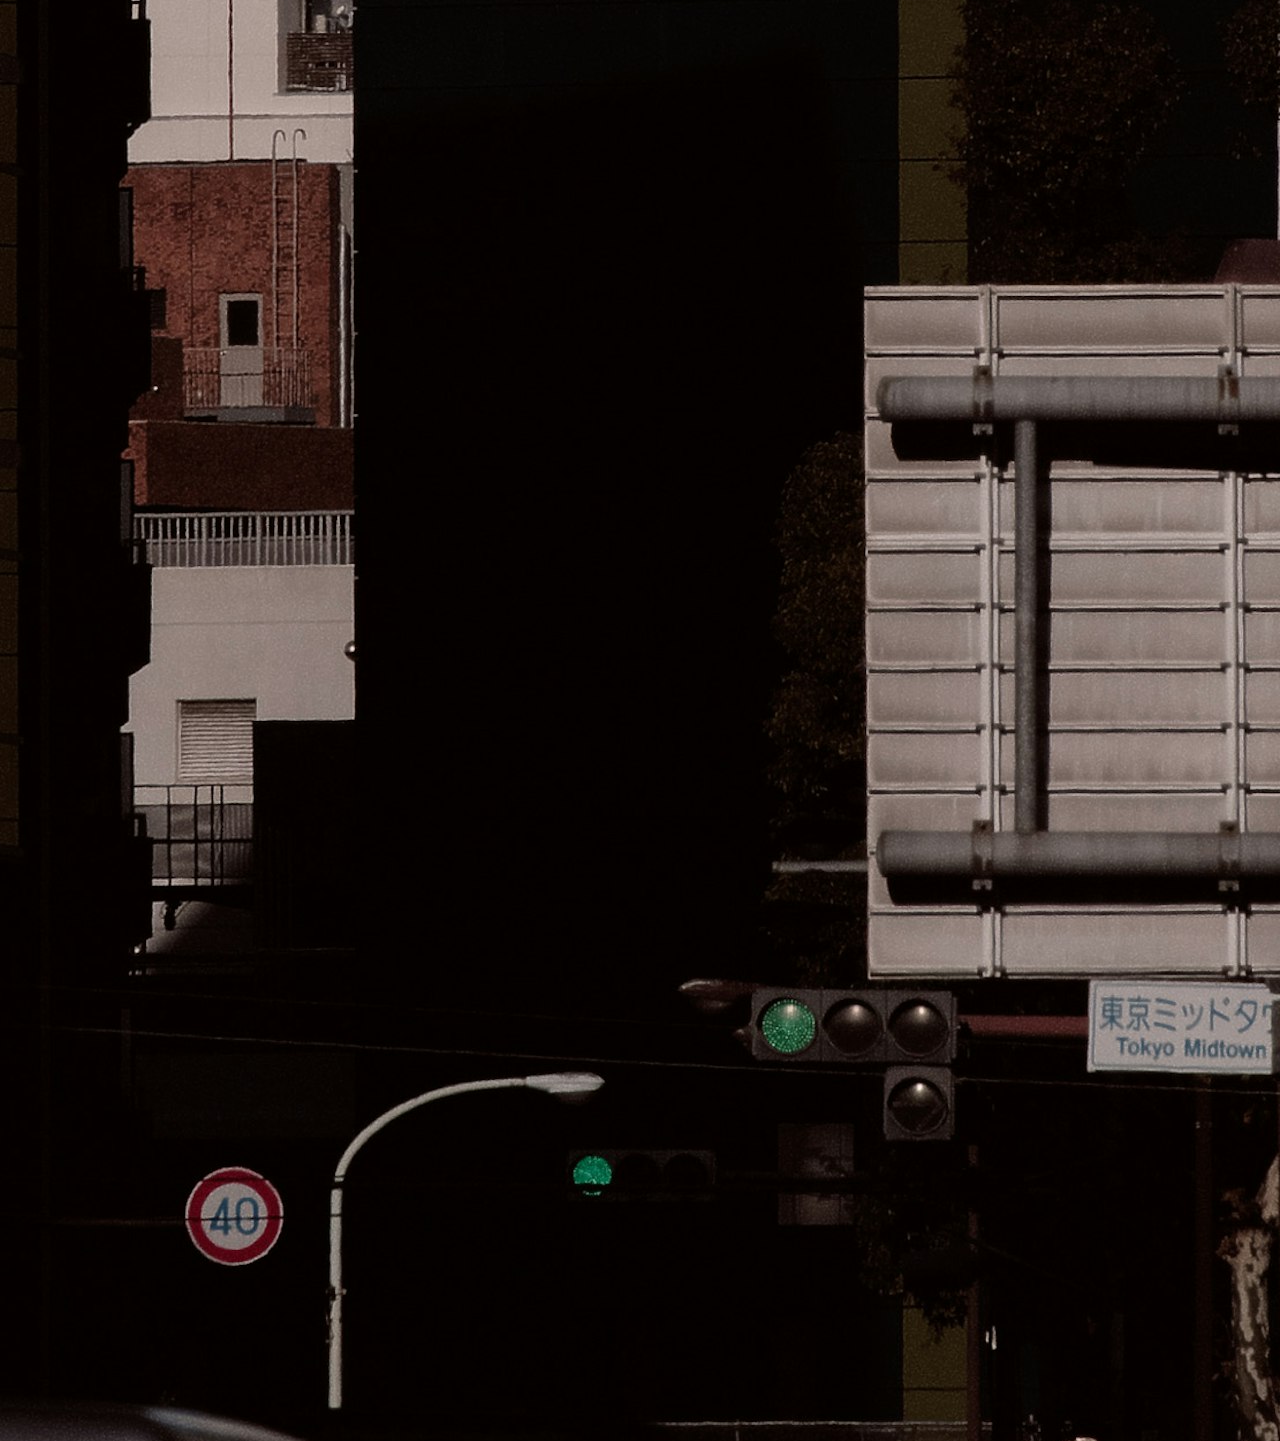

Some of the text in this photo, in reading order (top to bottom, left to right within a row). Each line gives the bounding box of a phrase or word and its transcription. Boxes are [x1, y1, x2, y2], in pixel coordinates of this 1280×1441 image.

[1117, 1036, 1267, 1060] Tokyo Midtown
[209, 1197, 259, 1236] 40
